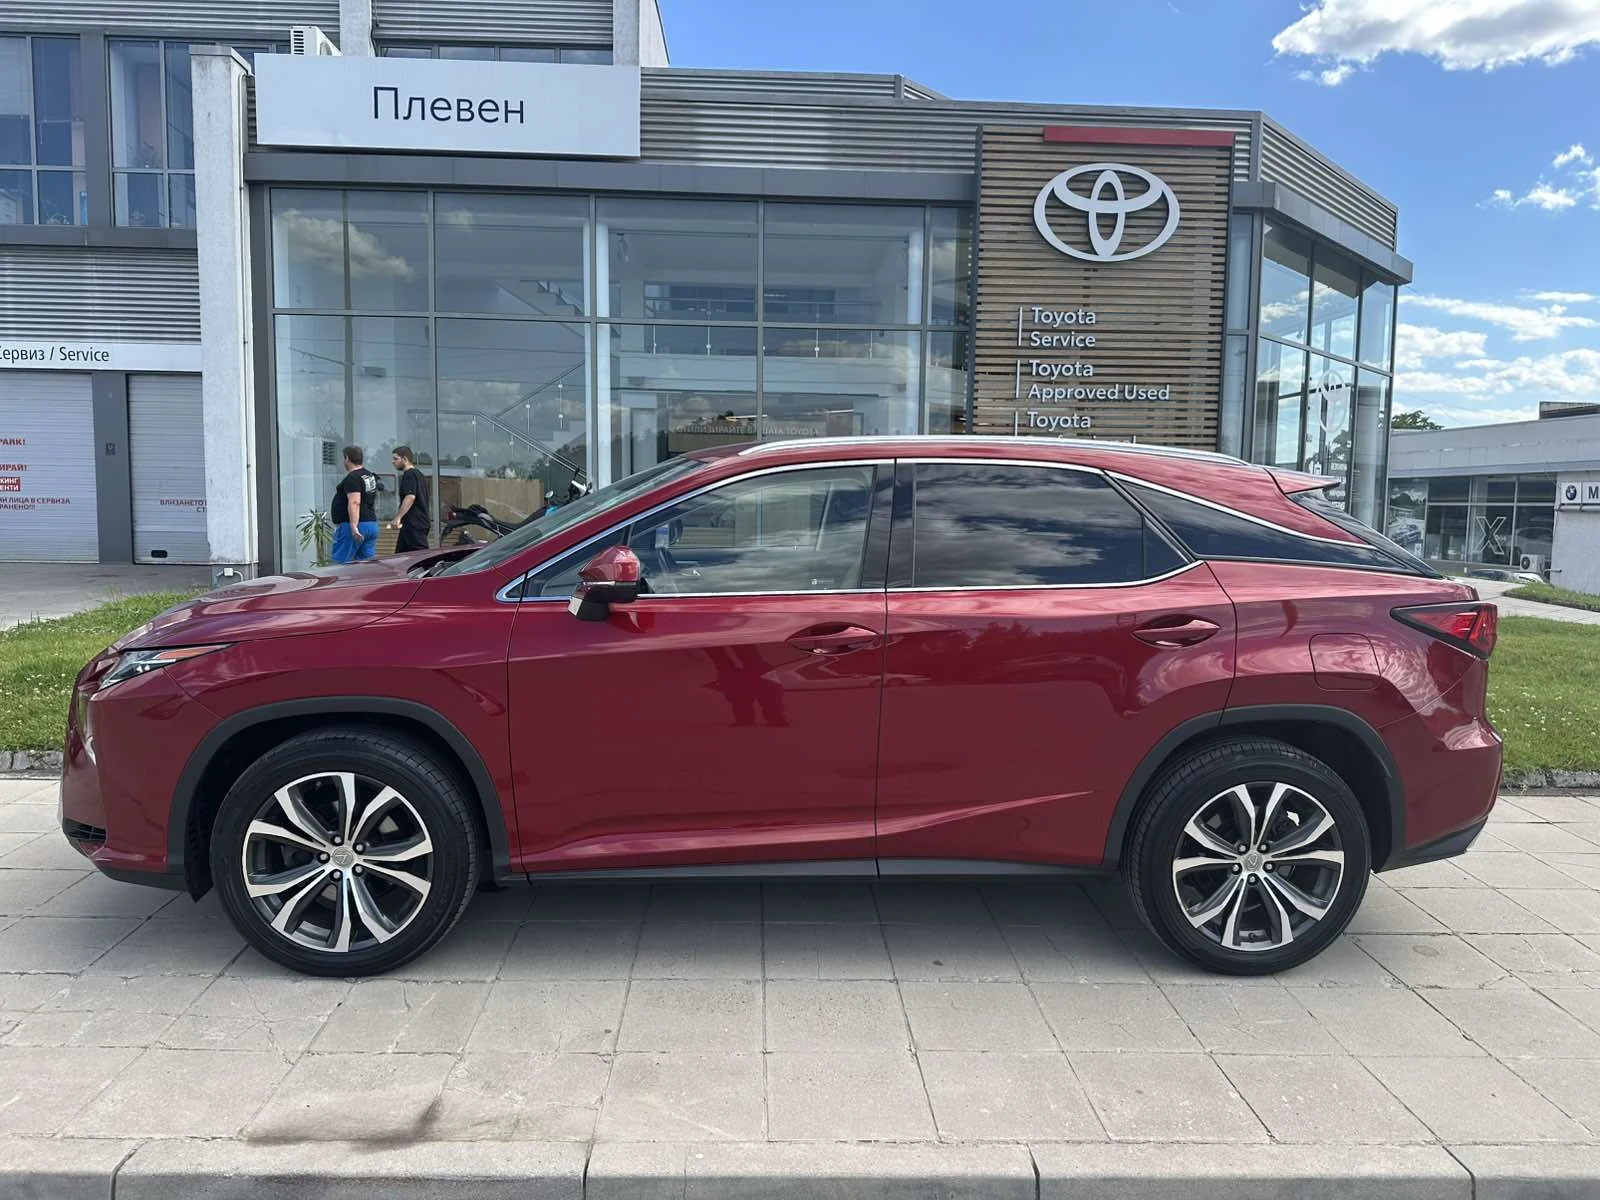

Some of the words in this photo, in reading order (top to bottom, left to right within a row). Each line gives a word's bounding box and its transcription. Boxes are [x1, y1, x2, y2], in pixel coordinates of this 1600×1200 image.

[373, 86, 525, 124] Плевен
[1031, 306, 1097, 327] Toyota
[1030, 331, 1096, 347] Service
[59, 346, 110, 362] Service
[1029, 360, 1094, 380] Toyota
[1028, 385, 1119, 402] Approved
[1124, 384, 1170, 401] Used
[1027, 411, 1091, 431] Toyota
